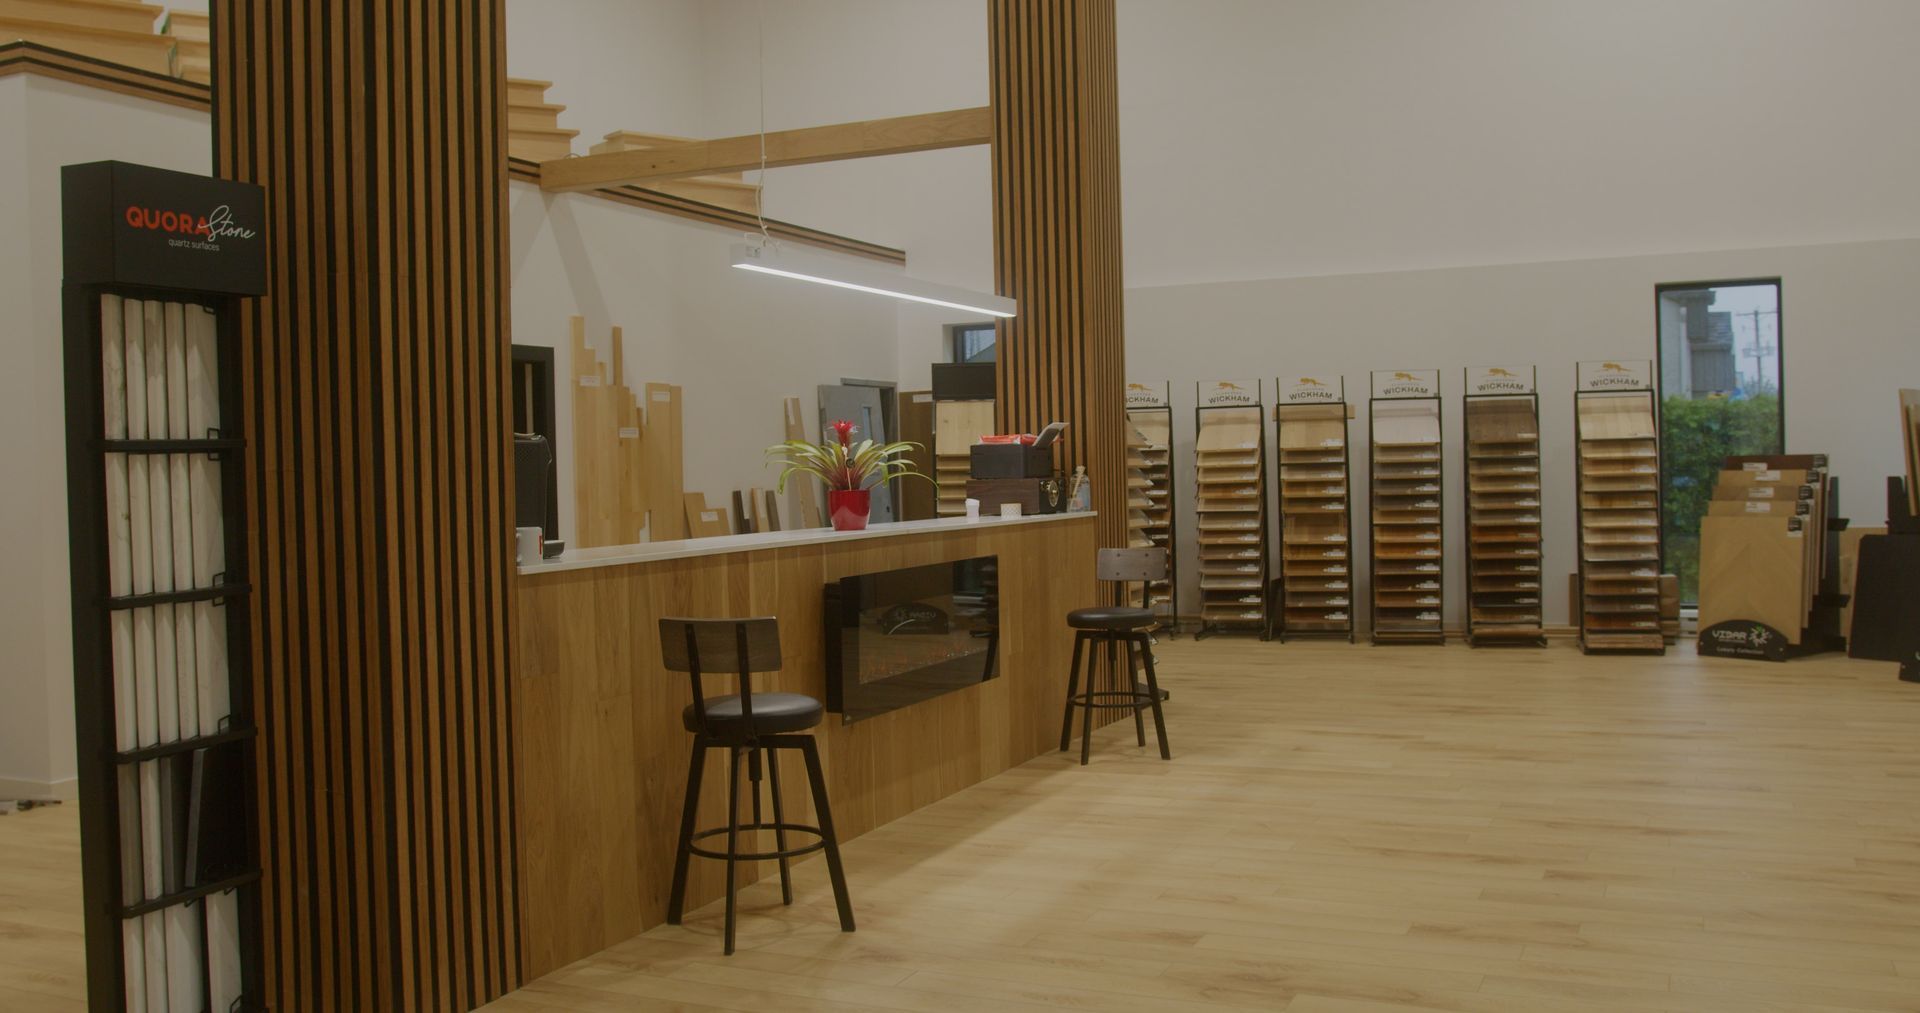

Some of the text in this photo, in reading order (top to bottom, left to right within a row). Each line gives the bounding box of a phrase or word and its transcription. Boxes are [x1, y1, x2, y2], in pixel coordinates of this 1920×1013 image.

[126, 205, 256, 242] QUORA Stone
[168, 239, 220, 252] quartz surfaces
[1477, 382, 1525, 392] WICKHAM
[1590, 377, 1640, 387] WICKHAM
[1289, 391, 1333, 401] WICKHAM
[1383, 386, 1429, 396] WICKHAM
[1125, 396, 1159, 404] ICKHAM
[1208, 395, 1250, 404] WICKHAM
